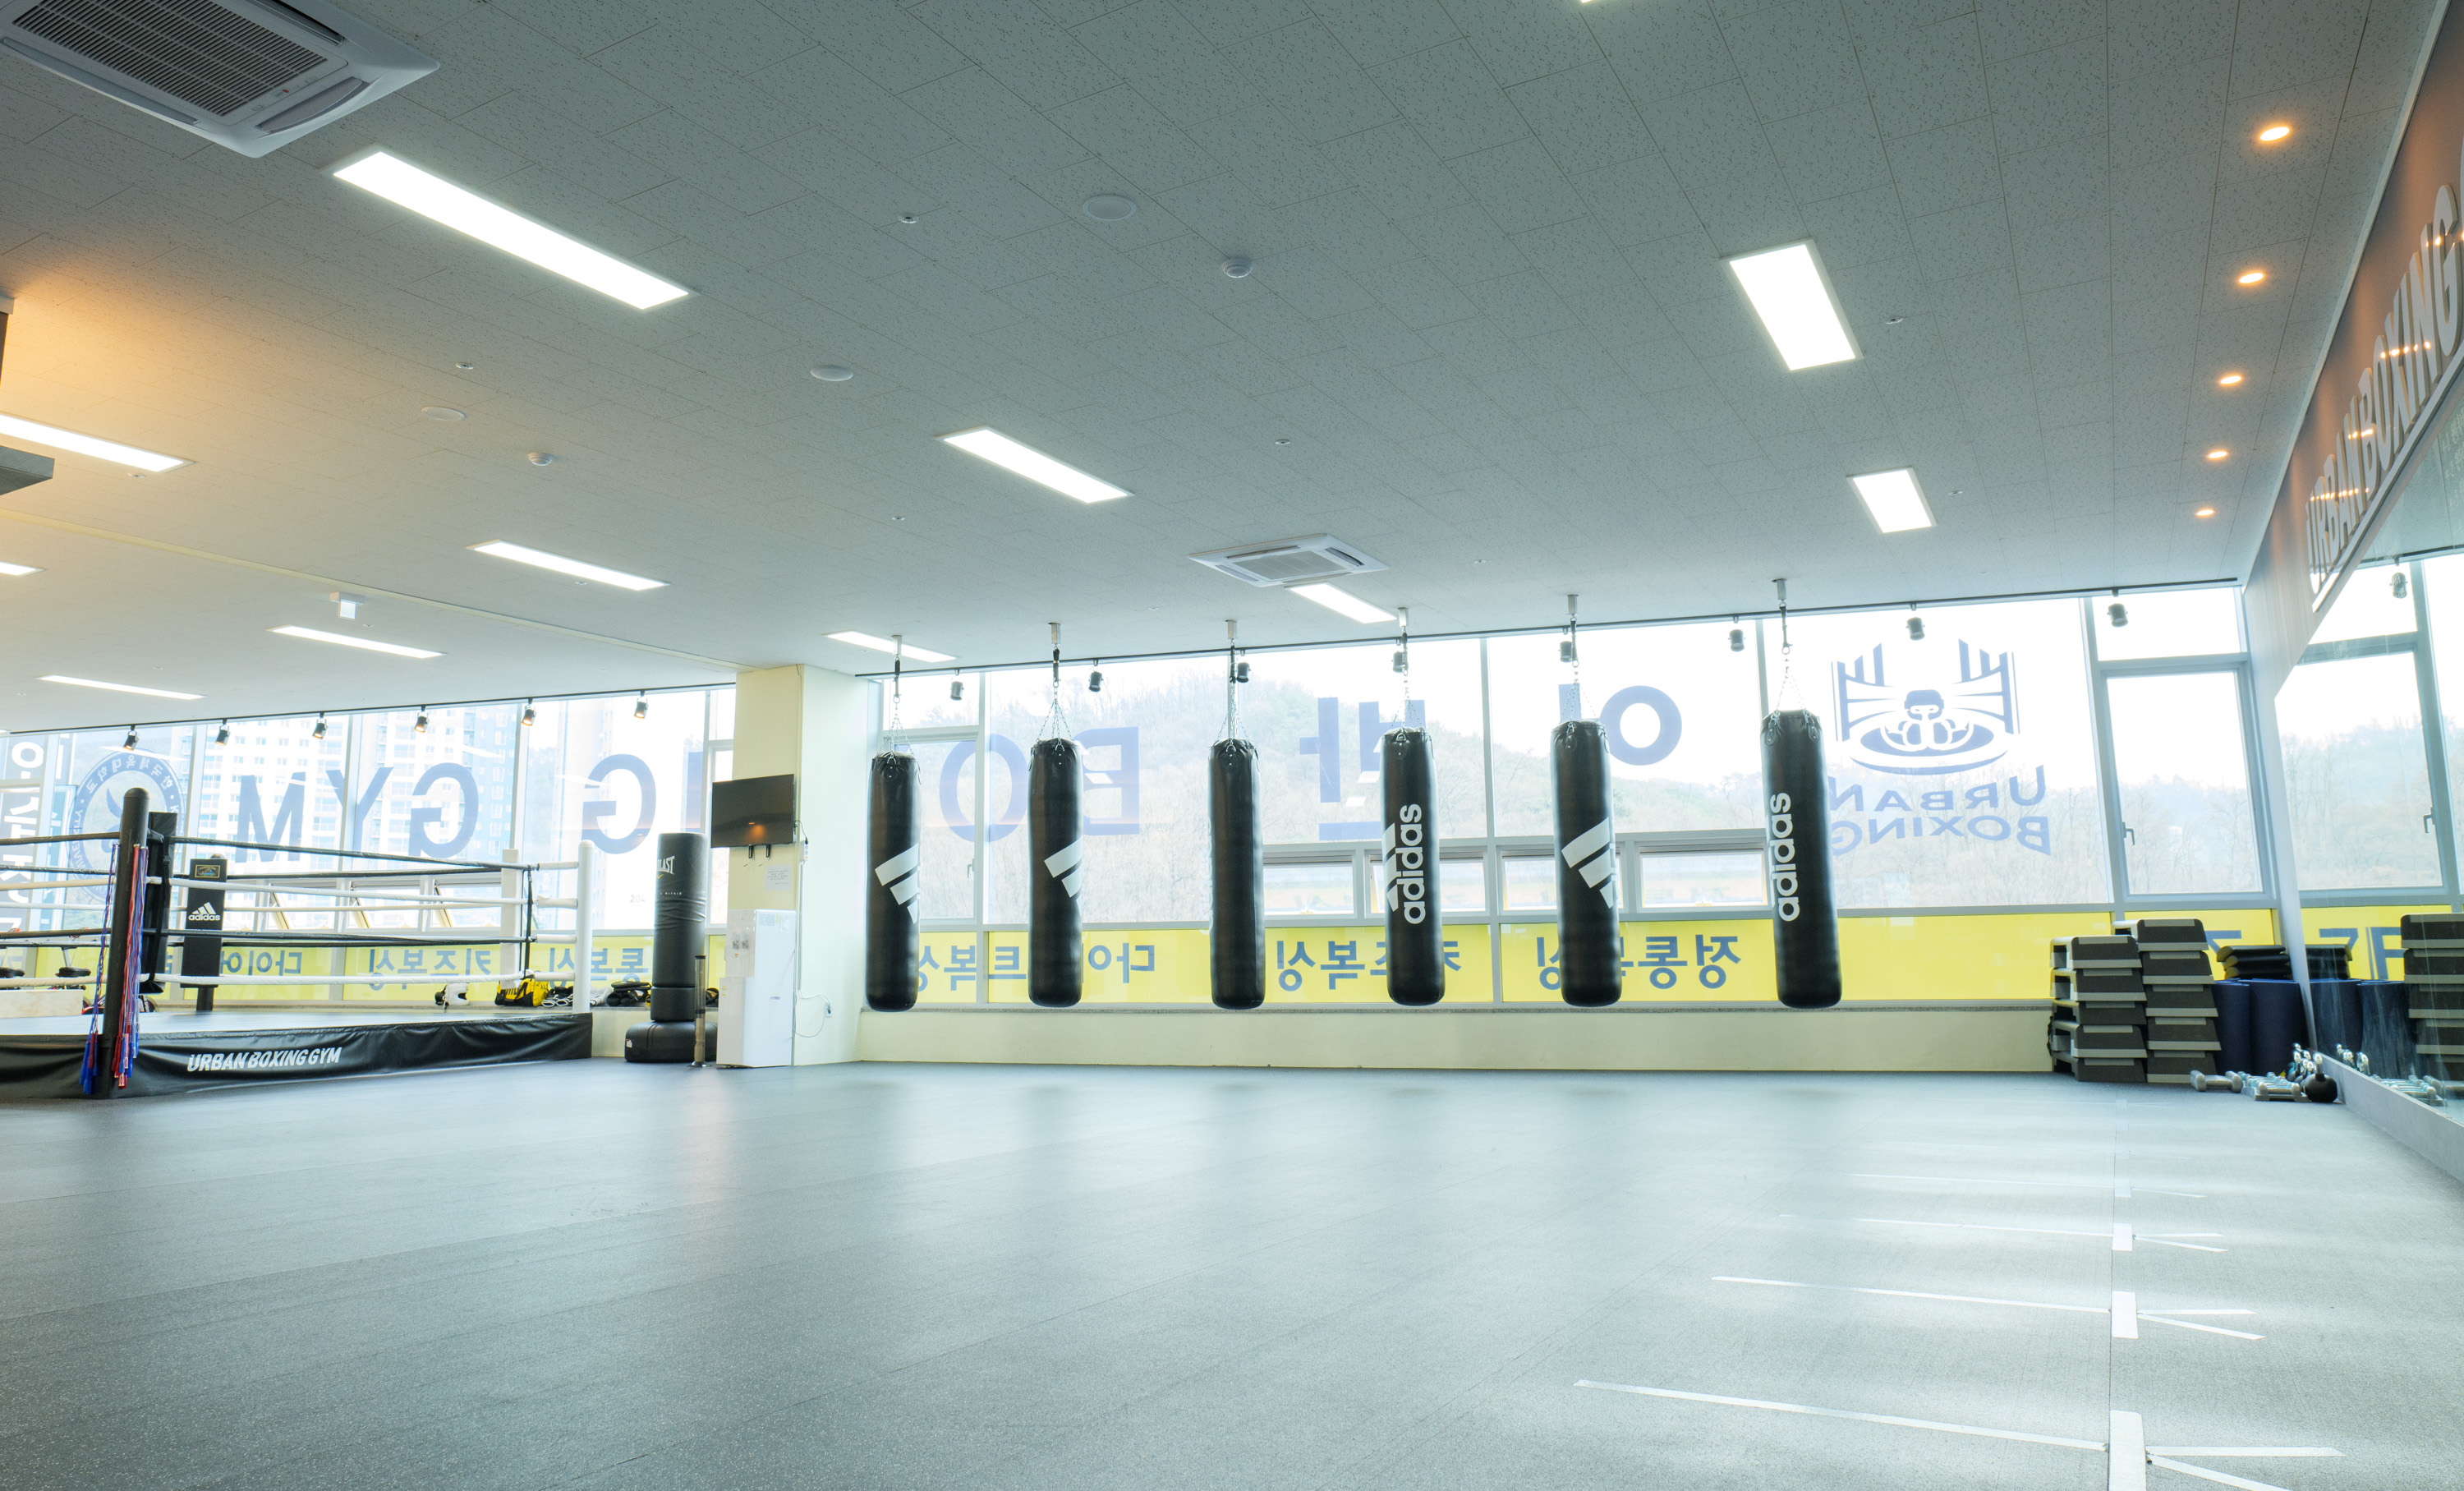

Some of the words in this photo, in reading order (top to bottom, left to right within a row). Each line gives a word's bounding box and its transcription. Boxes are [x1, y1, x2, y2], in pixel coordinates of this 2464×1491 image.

[2305, 395, 2370, 595] URBAN
[2357, 184, 2463, 502] BOXING
[188, 913, 221, 921] adidas
[1396, 803, 1426, 925] adidas
[1768, 792, 1800, 922] adidas
[187, 1052, 250, 1072] URBAN
[247, 1049, 309, 1069] BOXING
[308, 1047, 342, 1065] GYM
